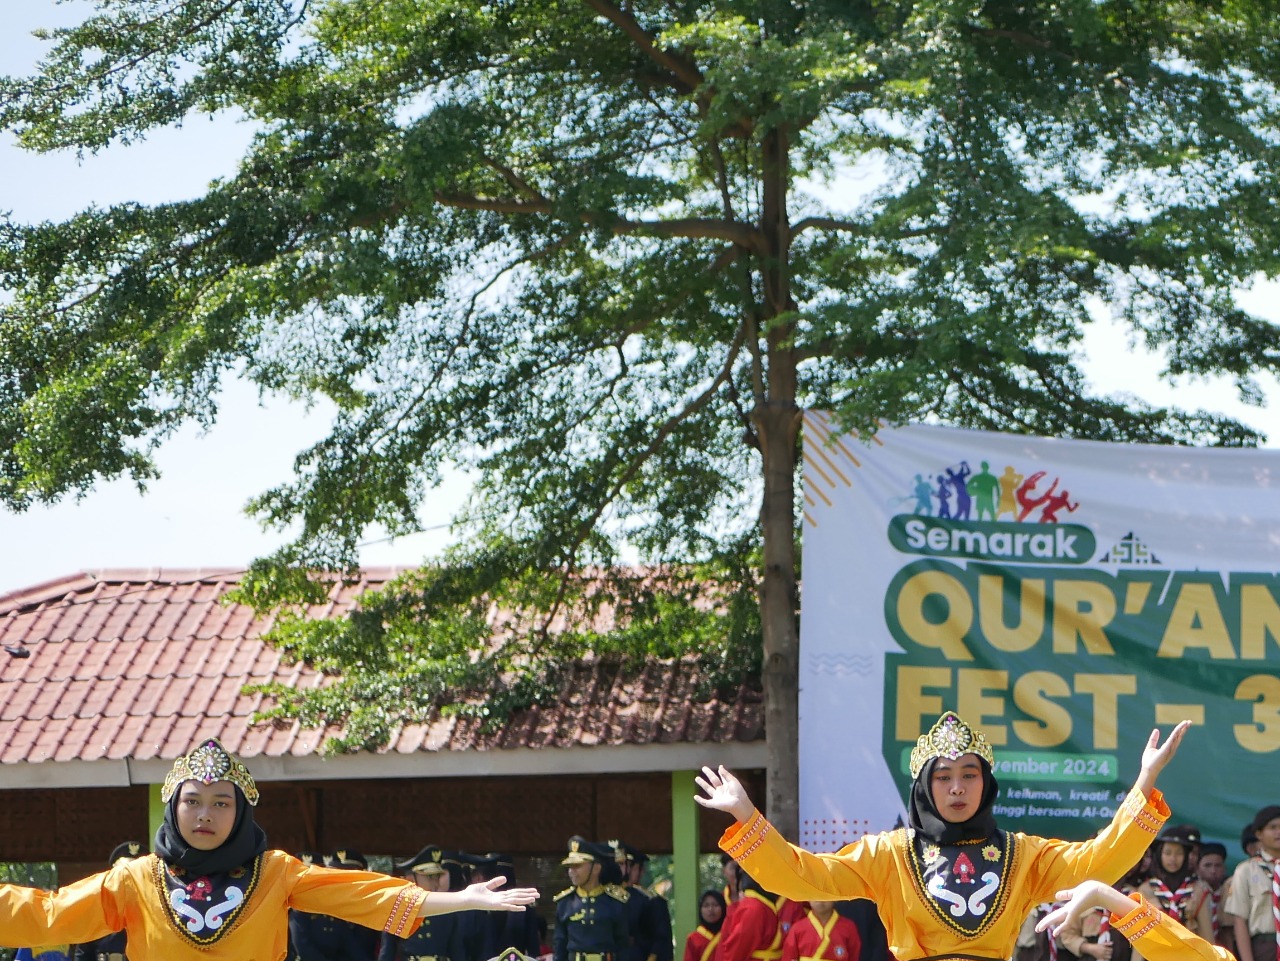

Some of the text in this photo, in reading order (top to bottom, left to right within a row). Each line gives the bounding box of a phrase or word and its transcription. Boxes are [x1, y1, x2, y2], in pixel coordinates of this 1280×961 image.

[904, 519, 1079, 559] Semarak
[895, 666, 1137, 750] FEST
[991, 757, 1110, 776] vember 2024
[1069, 789, 1110, 801] kreatif
[1028, 804, 1080, 817] bersama
